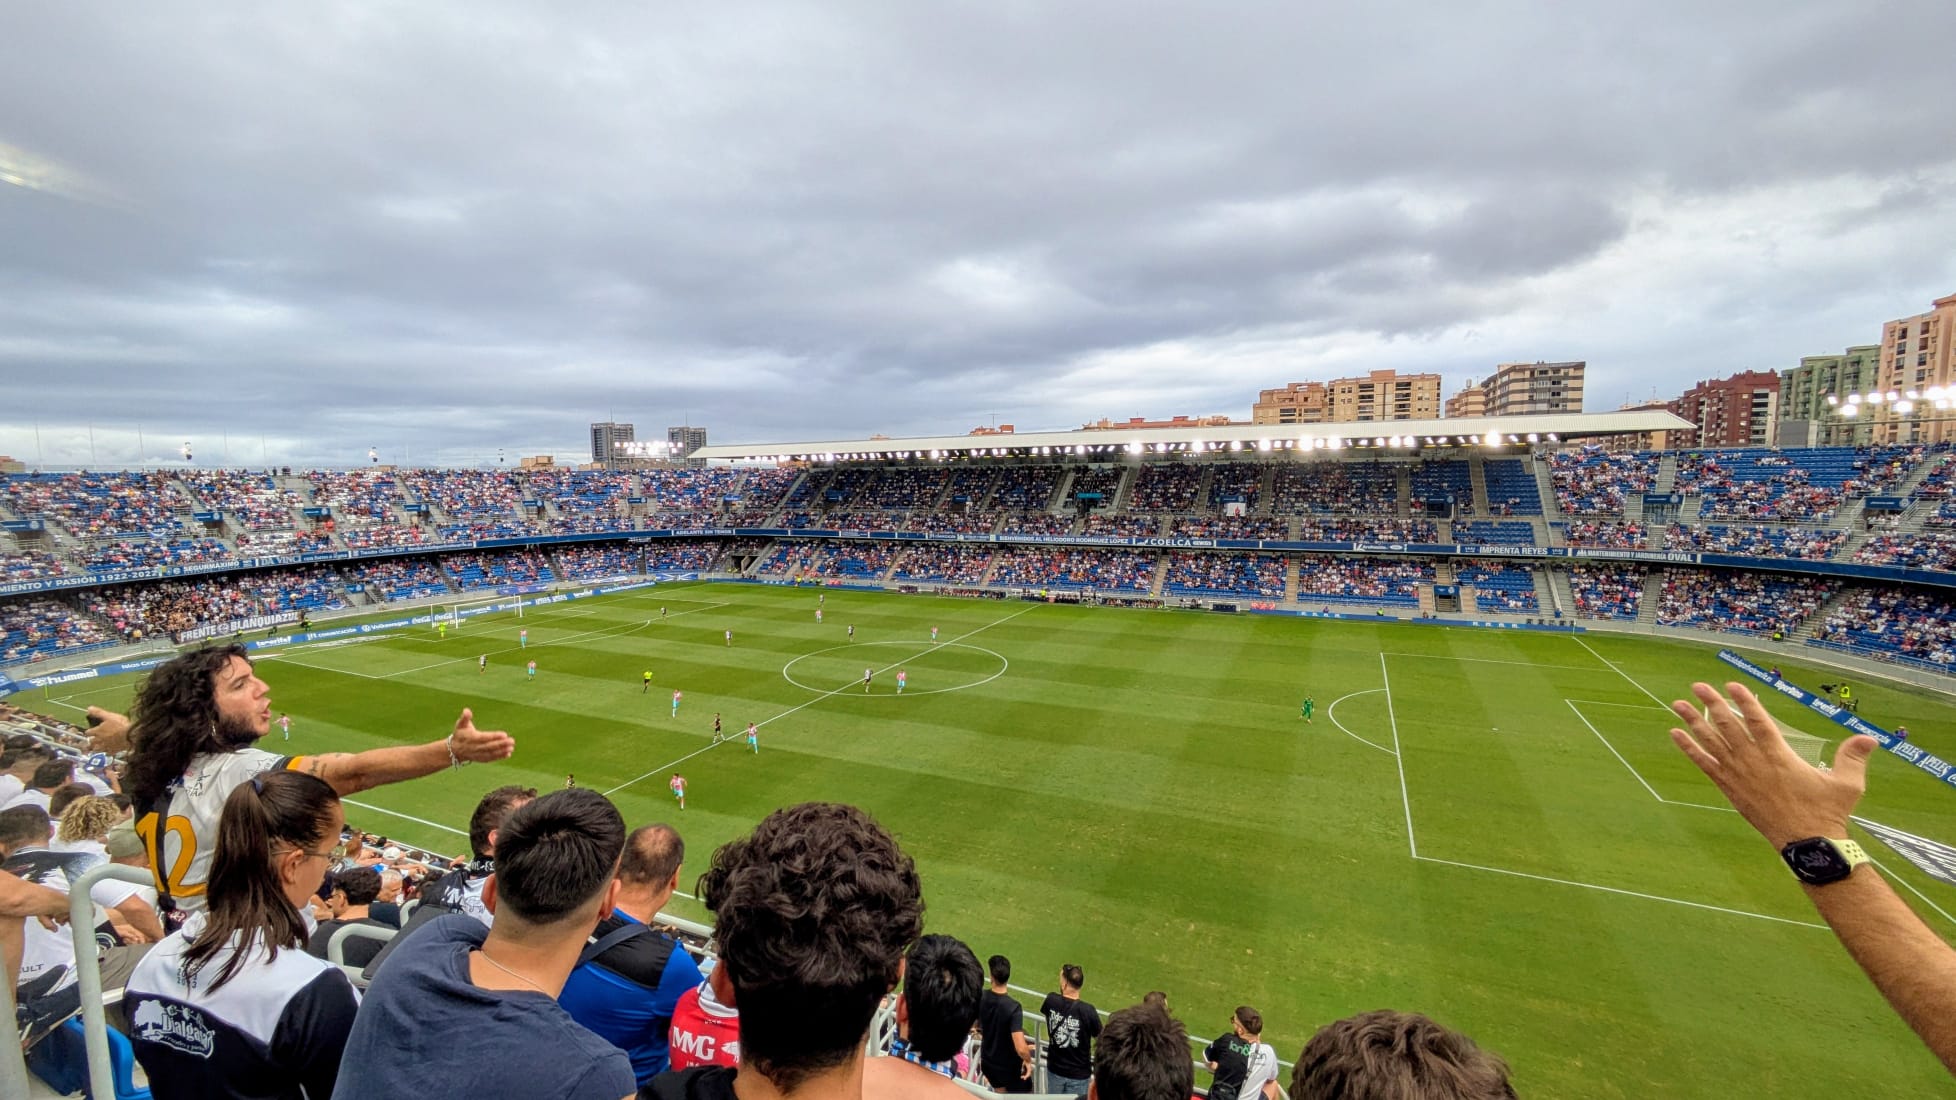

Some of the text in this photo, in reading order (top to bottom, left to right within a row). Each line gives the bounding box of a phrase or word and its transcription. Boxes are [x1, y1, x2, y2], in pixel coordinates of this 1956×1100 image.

[1150, 538, 1191, 546] COELCA
[1480, 546, 1520, 554] IMPRENTA
[1521, 547, 1548, 556] REYES
[1587, 550, 1631, 559] MANTENIMIENTO
[1667, 553, 1693, 562] OVAL
[45, 580, 54, 588] Y
[56, 575, 97, 587] PASIÓN
[100, 568, 160, 582] 1922-2022
[180, 611, 300, 642] FRENTE BLANQUIAZUL
[48, 668, 99, 685] hummel
[1889, 740, 1924, 763] APELES
[1915, 754, 1952, 779] APELES
[135, 811, 208, 898] 12
[672, 1025, 716, 1061] MMG
